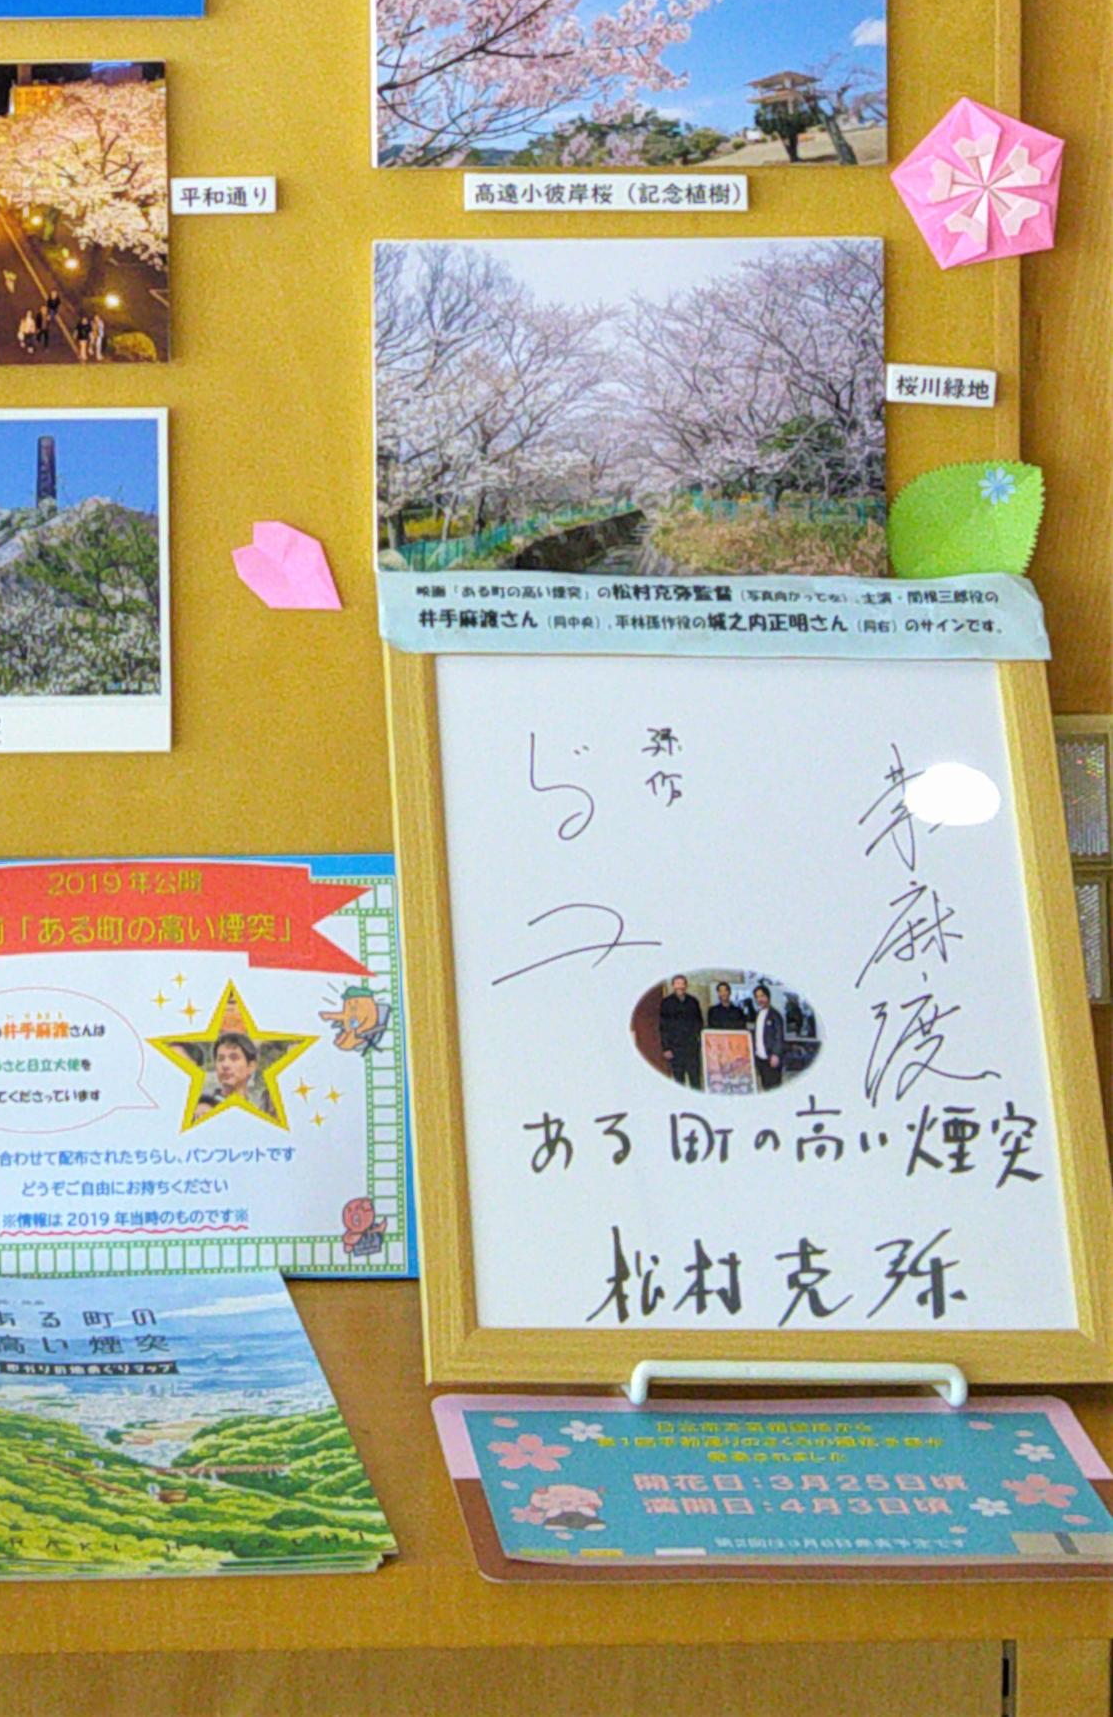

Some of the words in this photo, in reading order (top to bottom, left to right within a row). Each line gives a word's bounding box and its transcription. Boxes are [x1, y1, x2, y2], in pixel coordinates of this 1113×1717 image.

[178, 185, 270, 209] 平和通り
[894, 373, 991, 402] 桜川緑地
[47, 869, 203, 896] 2019年公開
[21, 1178, 229, 1198] どうぞご自由にお持ちください
